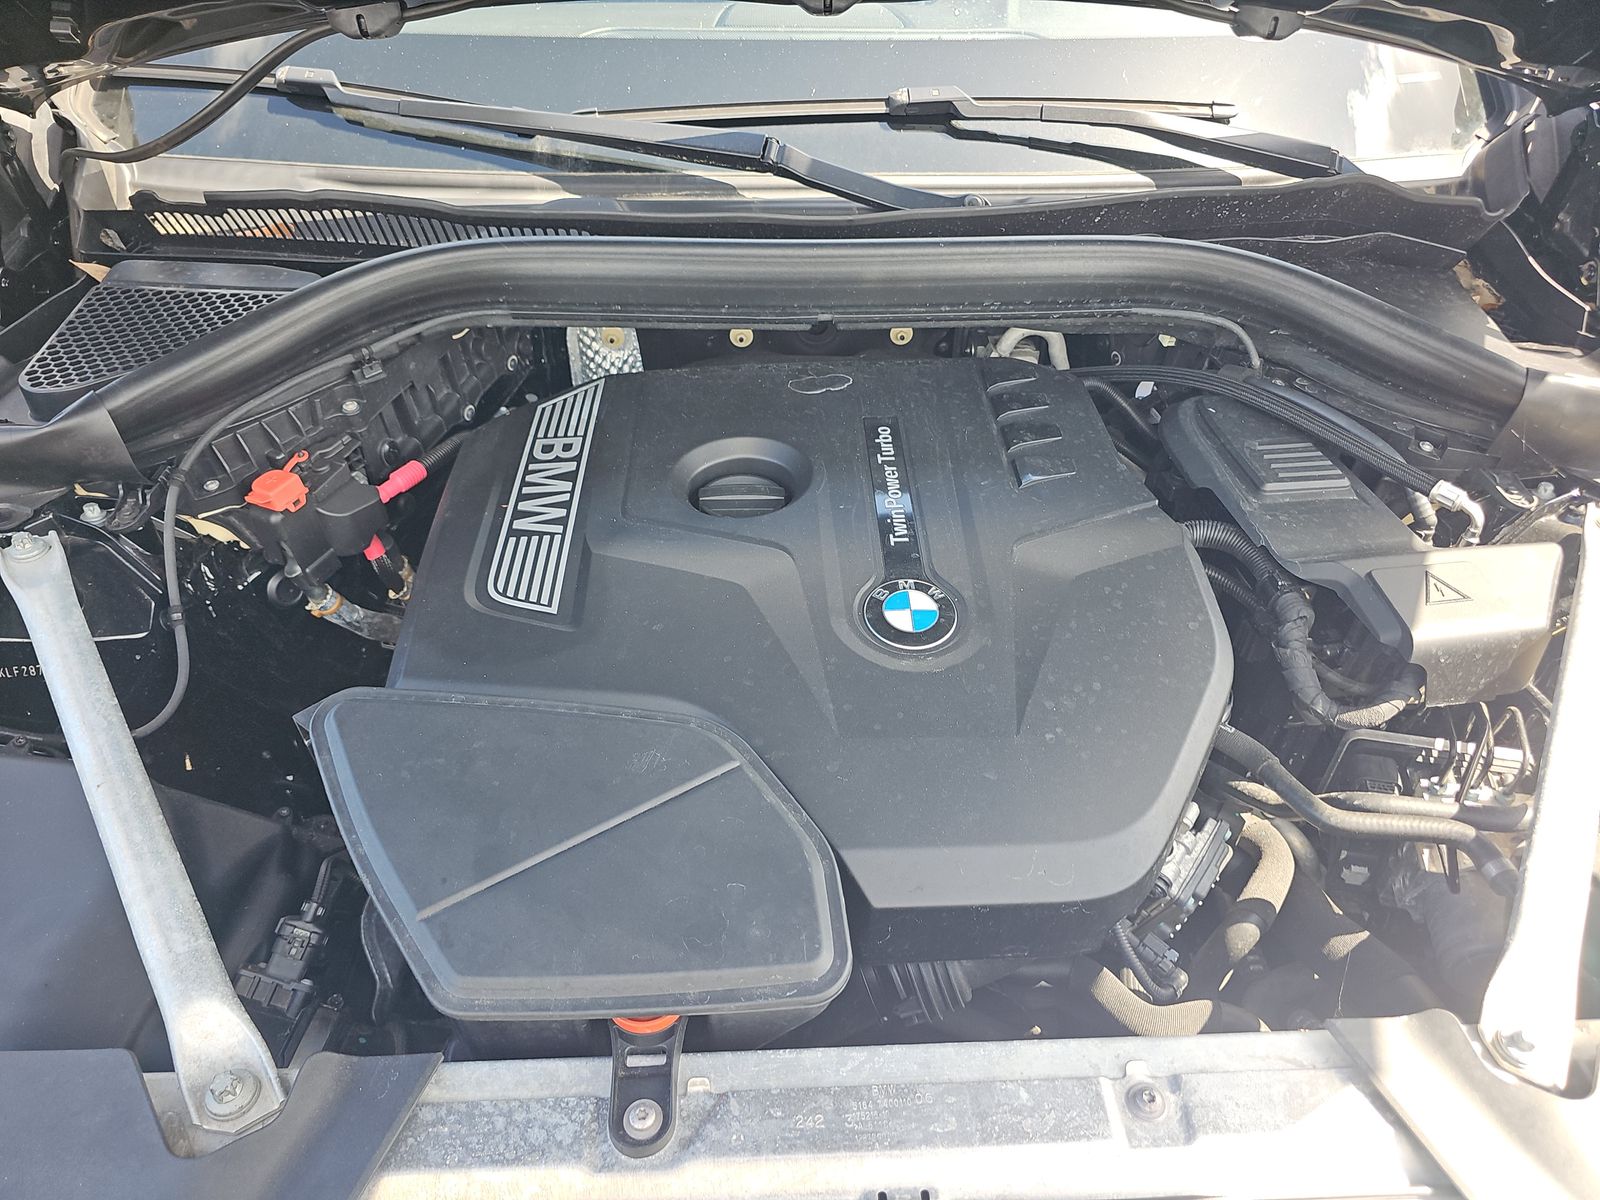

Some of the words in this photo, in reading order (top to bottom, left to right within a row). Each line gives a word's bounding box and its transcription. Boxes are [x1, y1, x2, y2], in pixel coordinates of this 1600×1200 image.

[875, 426, 896, 464] Turbo
[512, 437, 583, 533] BMW
[884, 464, 910, 546] TwinPower
[872, 580, 946, 601] BMW
